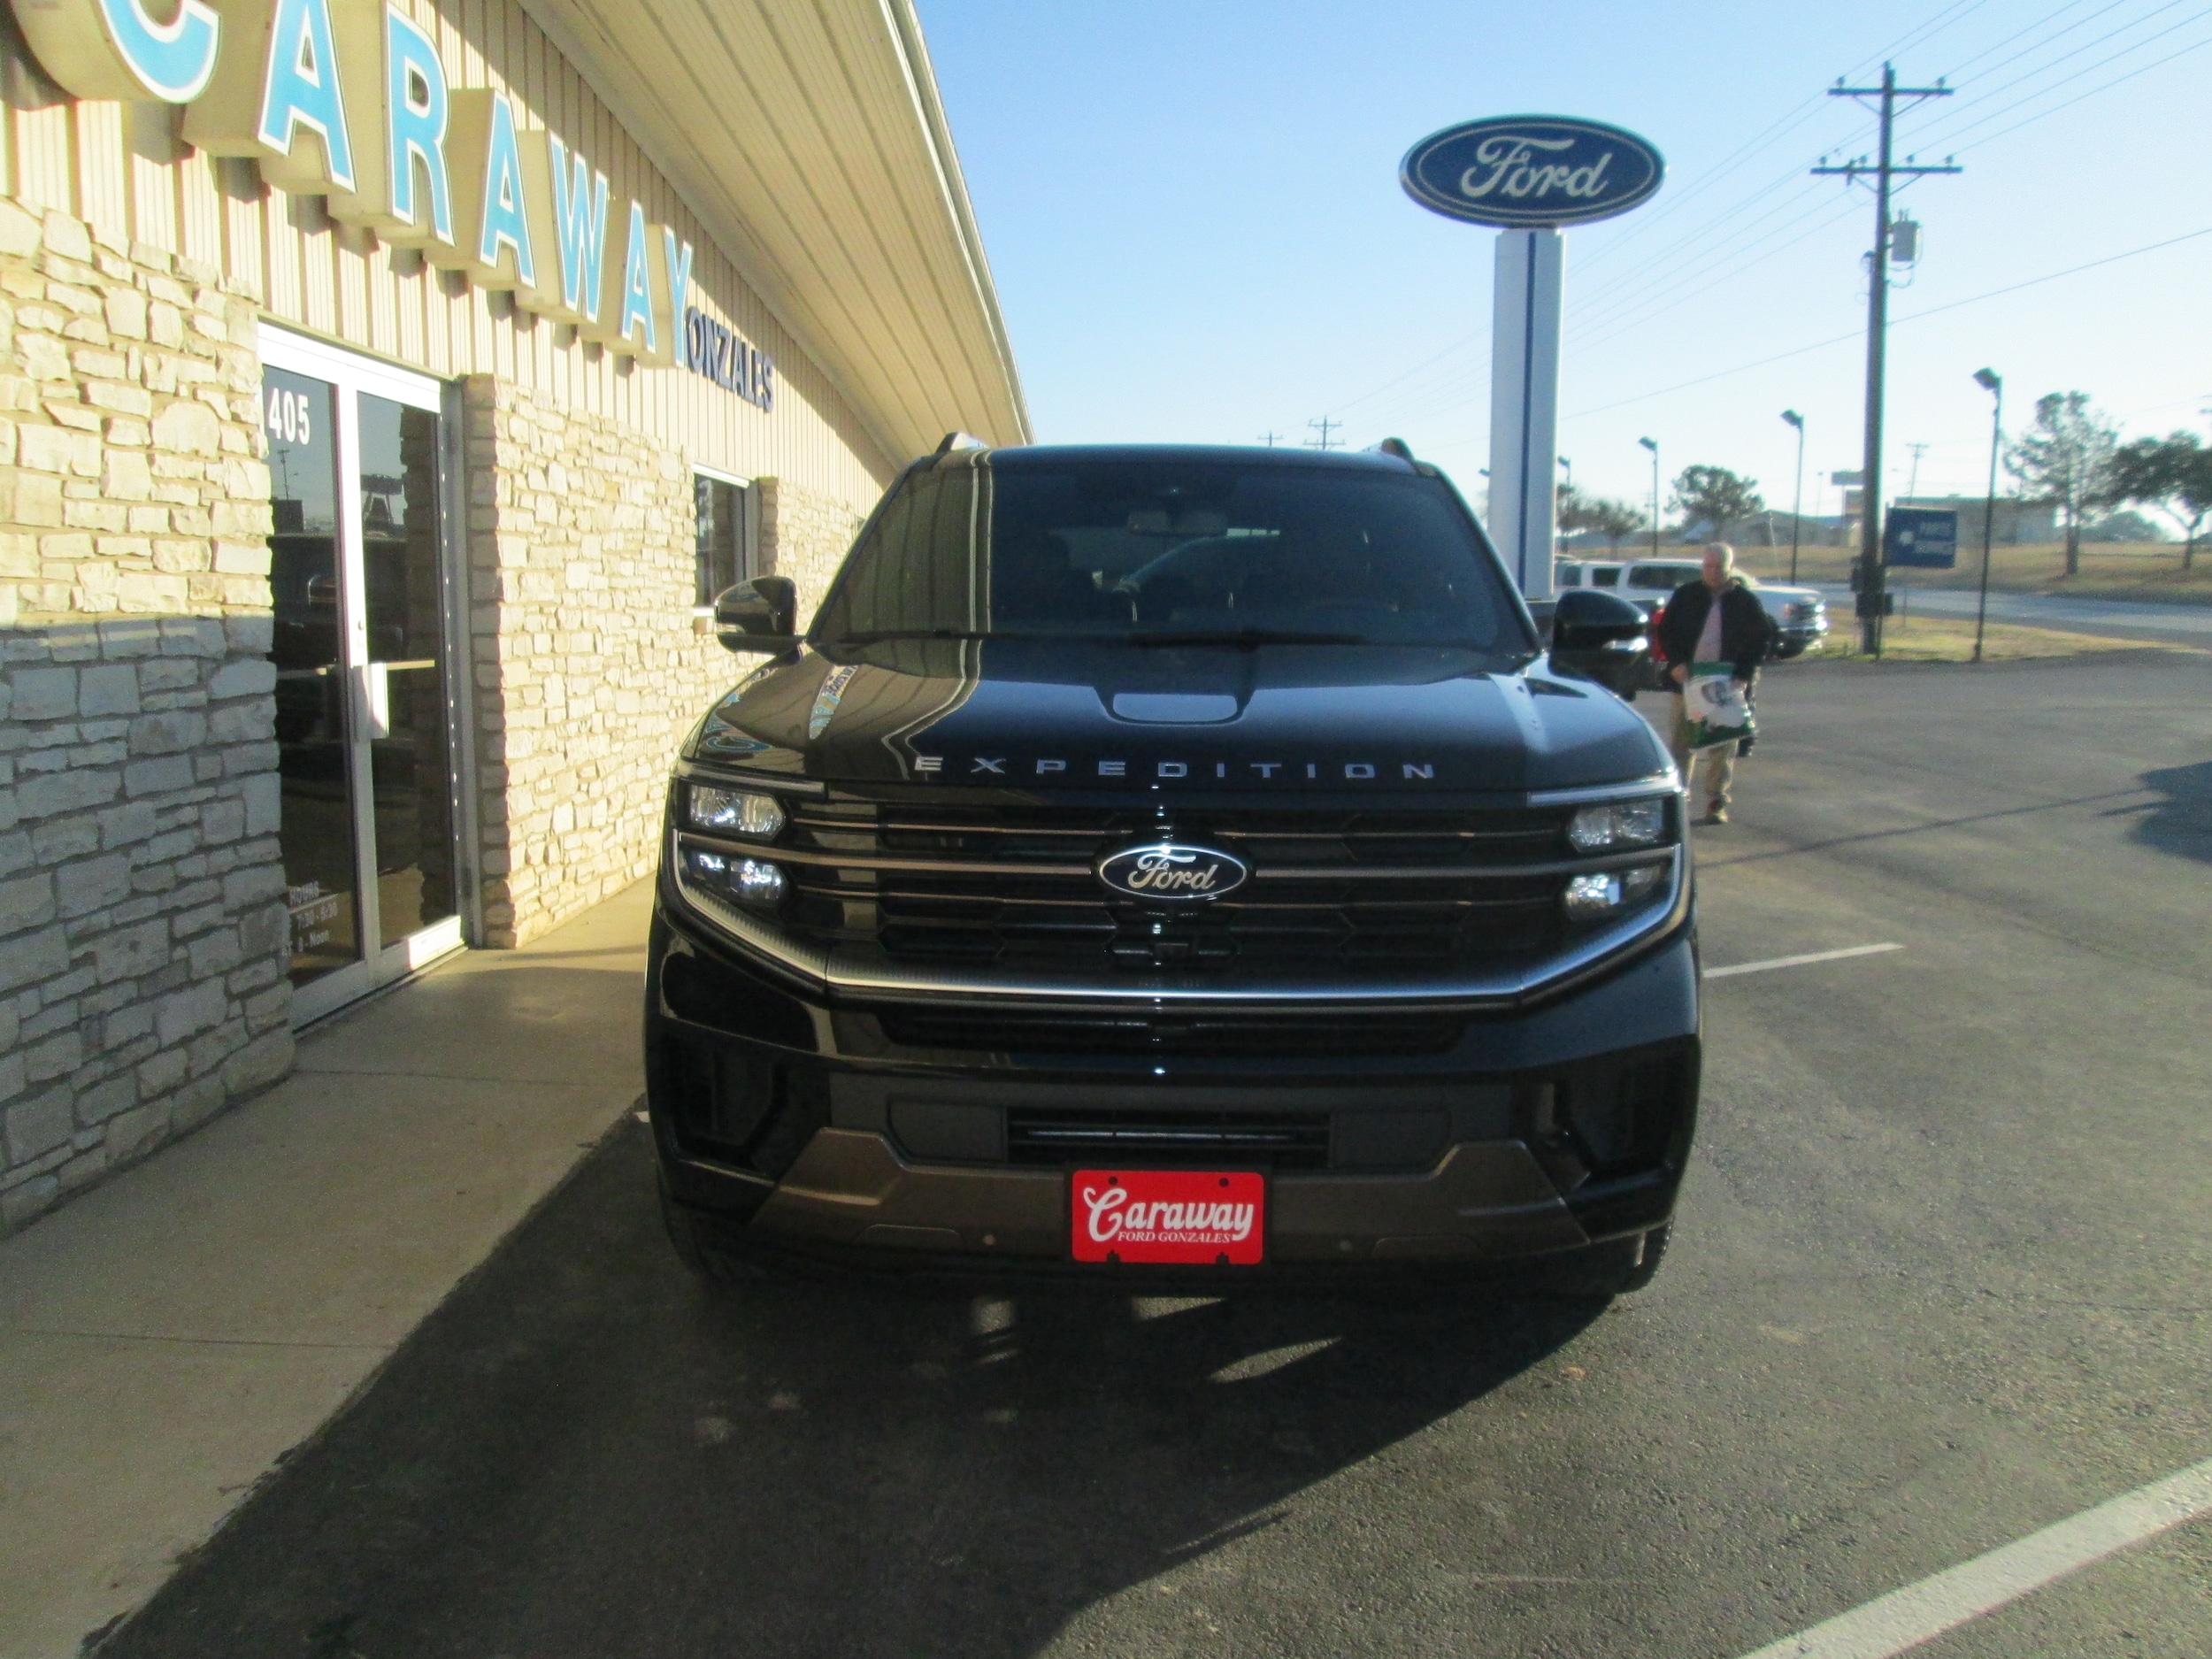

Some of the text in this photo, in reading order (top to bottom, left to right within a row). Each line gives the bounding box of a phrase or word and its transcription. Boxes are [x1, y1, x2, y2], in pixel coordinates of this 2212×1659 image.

[1460, 134, 1613, 198] Ford
[685, 305, 774, 413] ONZALES
[269, 388, 310, 445] 405
[914, 756, 1434, 779] EXPEDITION
[1127, 852, 1218, 890] Ford
[1083, 1187, 1254, 1242] Caraway
[1118, 1231, 1232, 1243] FORD GONZALES
